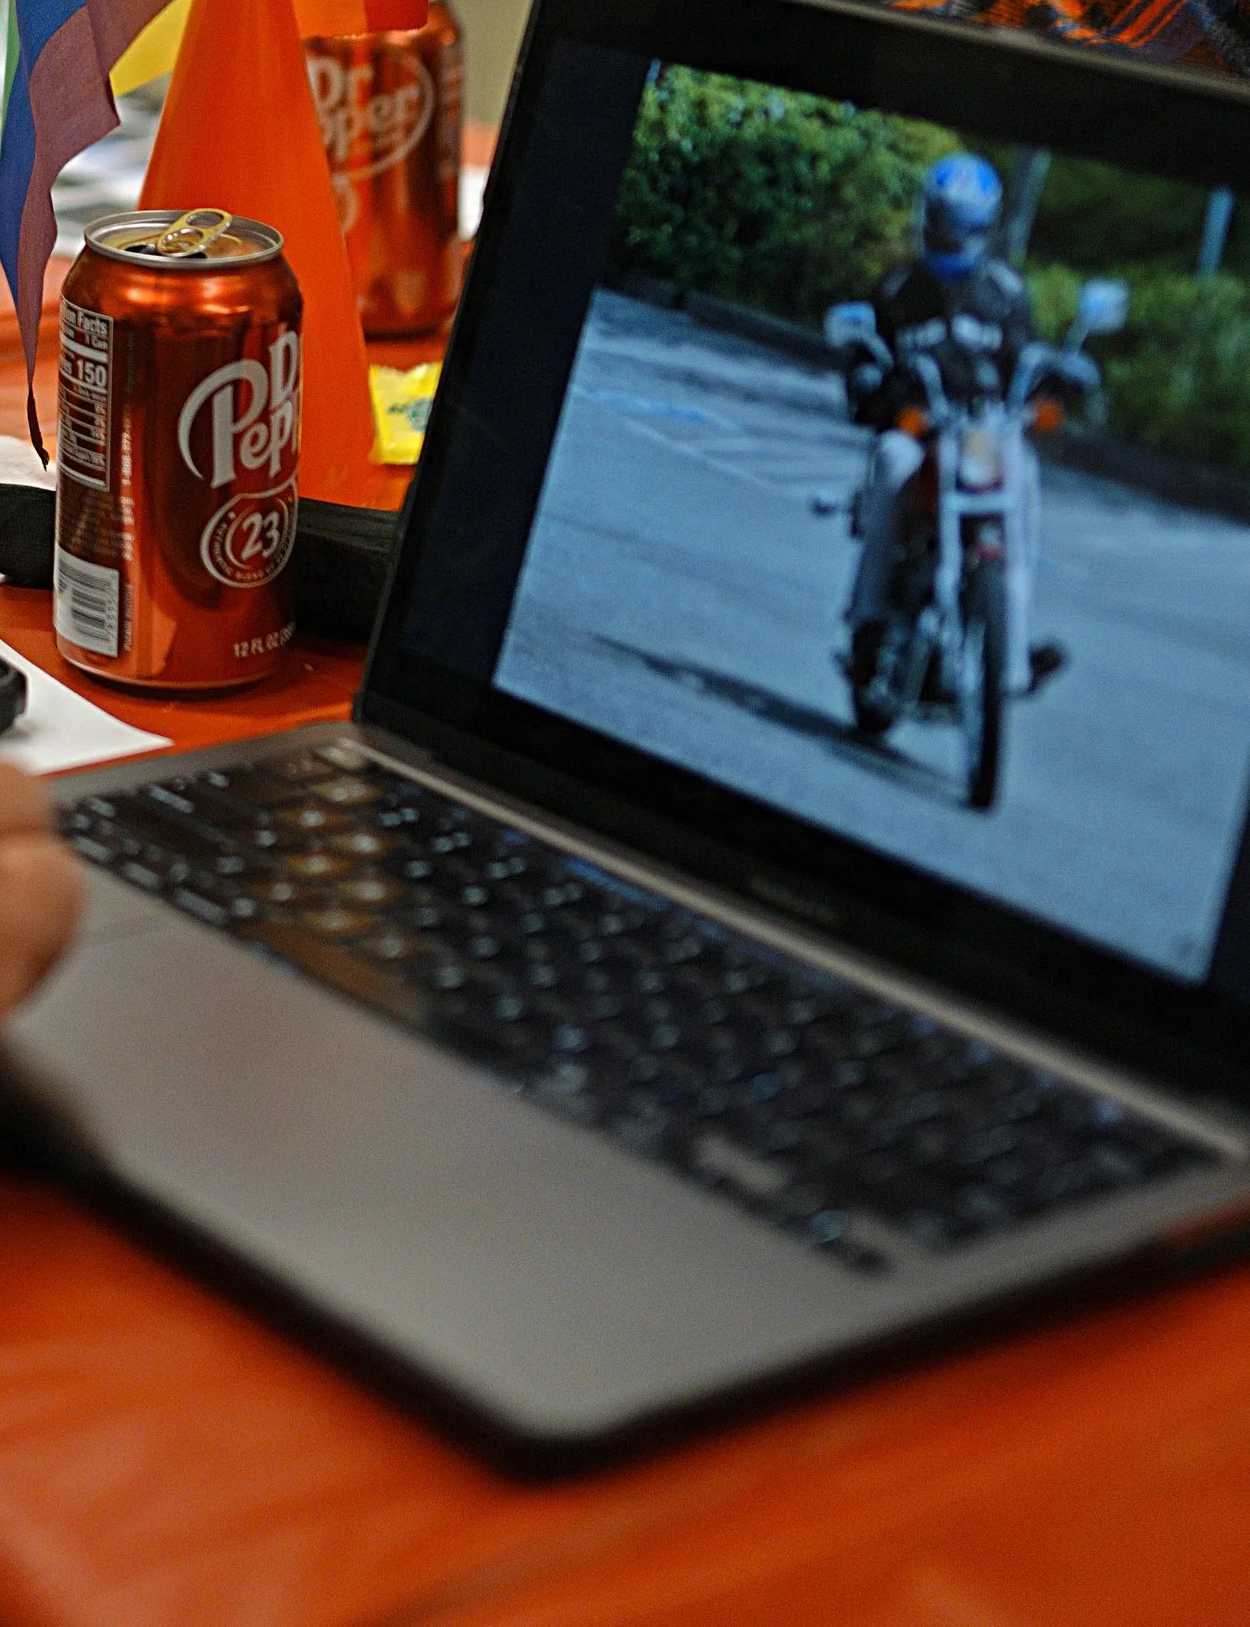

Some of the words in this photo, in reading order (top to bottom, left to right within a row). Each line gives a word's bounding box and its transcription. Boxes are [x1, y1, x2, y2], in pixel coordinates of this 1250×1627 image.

[77, 310, 108, 336] Facts
[77, 359, 107, 388] 150
[178, 359, 299, 490] Pep
[242, 511, 280, 561] 23
